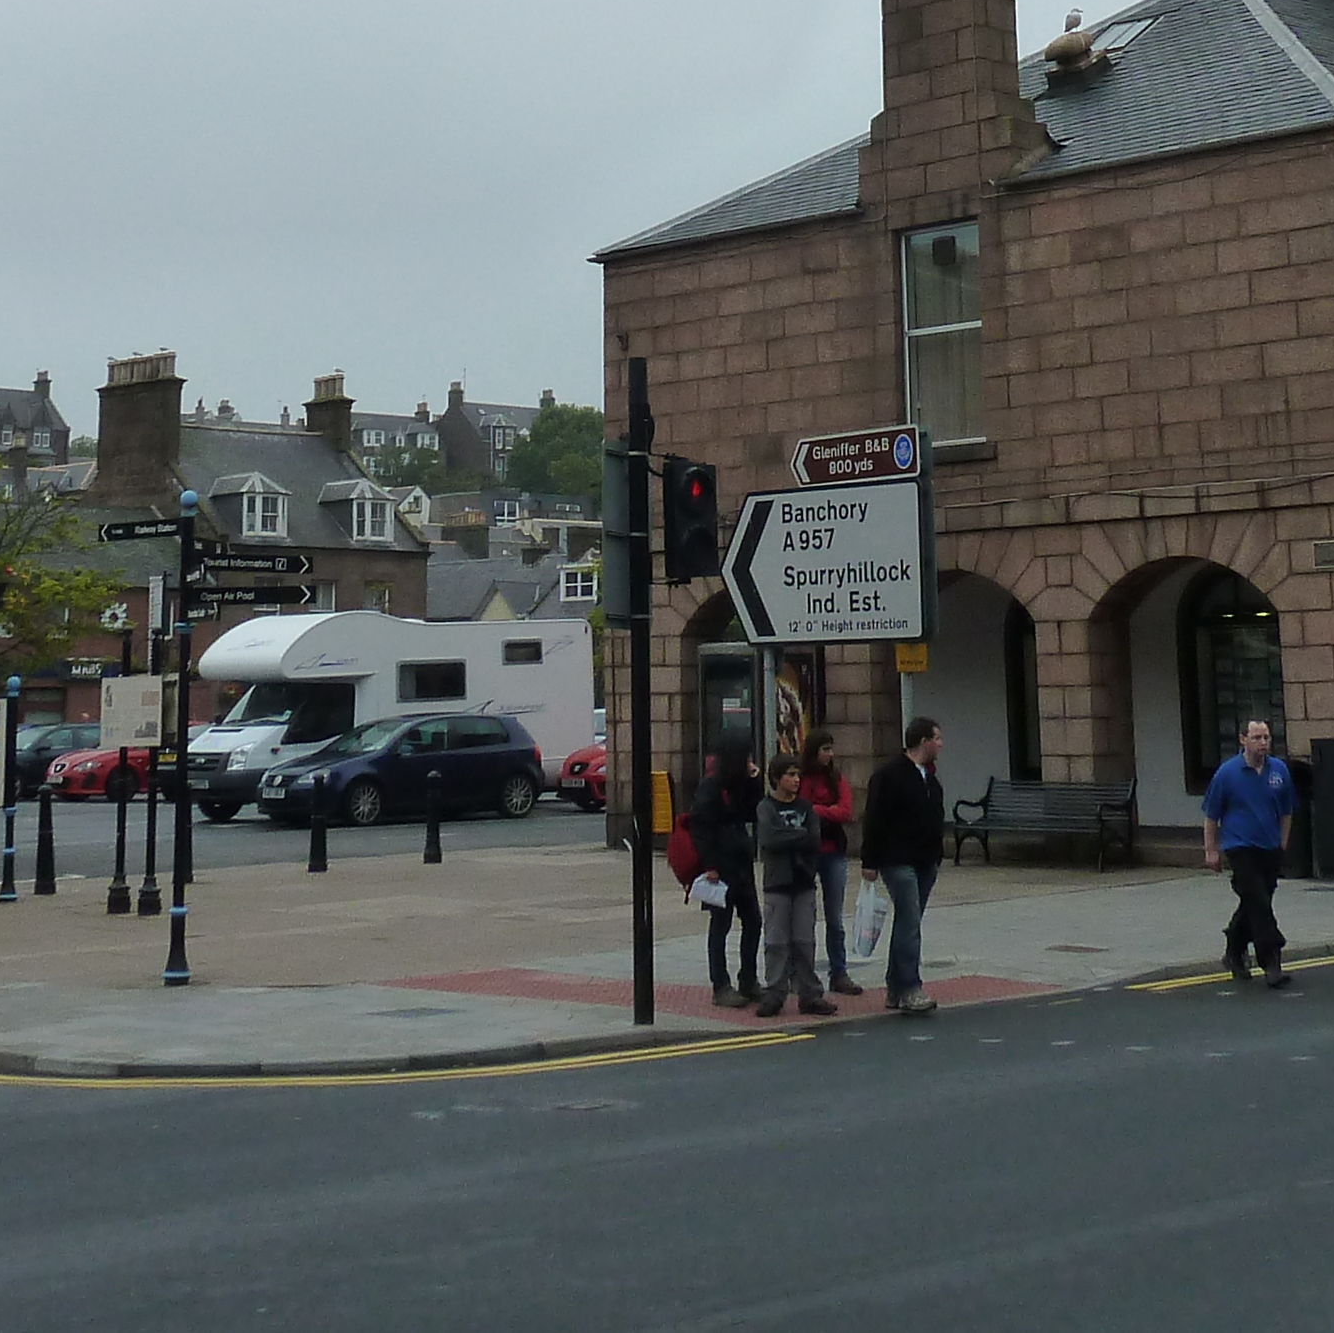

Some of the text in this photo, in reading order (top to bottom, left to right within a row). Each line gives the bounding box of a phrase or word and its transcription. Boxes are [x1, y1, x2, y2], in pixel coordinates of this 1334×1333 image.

[813, 438, 890, 460] Gleniffer B&B
[829, 458, 874, 475] 800 yds
[781, 499, 868, 524] Banchory
[230, 558, 272, 568] Information
[783, 559, 911, 589] Spurryhillock
[200, 590, 255, 602] Open Air Pool
[807, 590, 886, 614] Ind. Est.
[822, 620, 853, 633] Height
[856, 618, 908, 631] restriction
